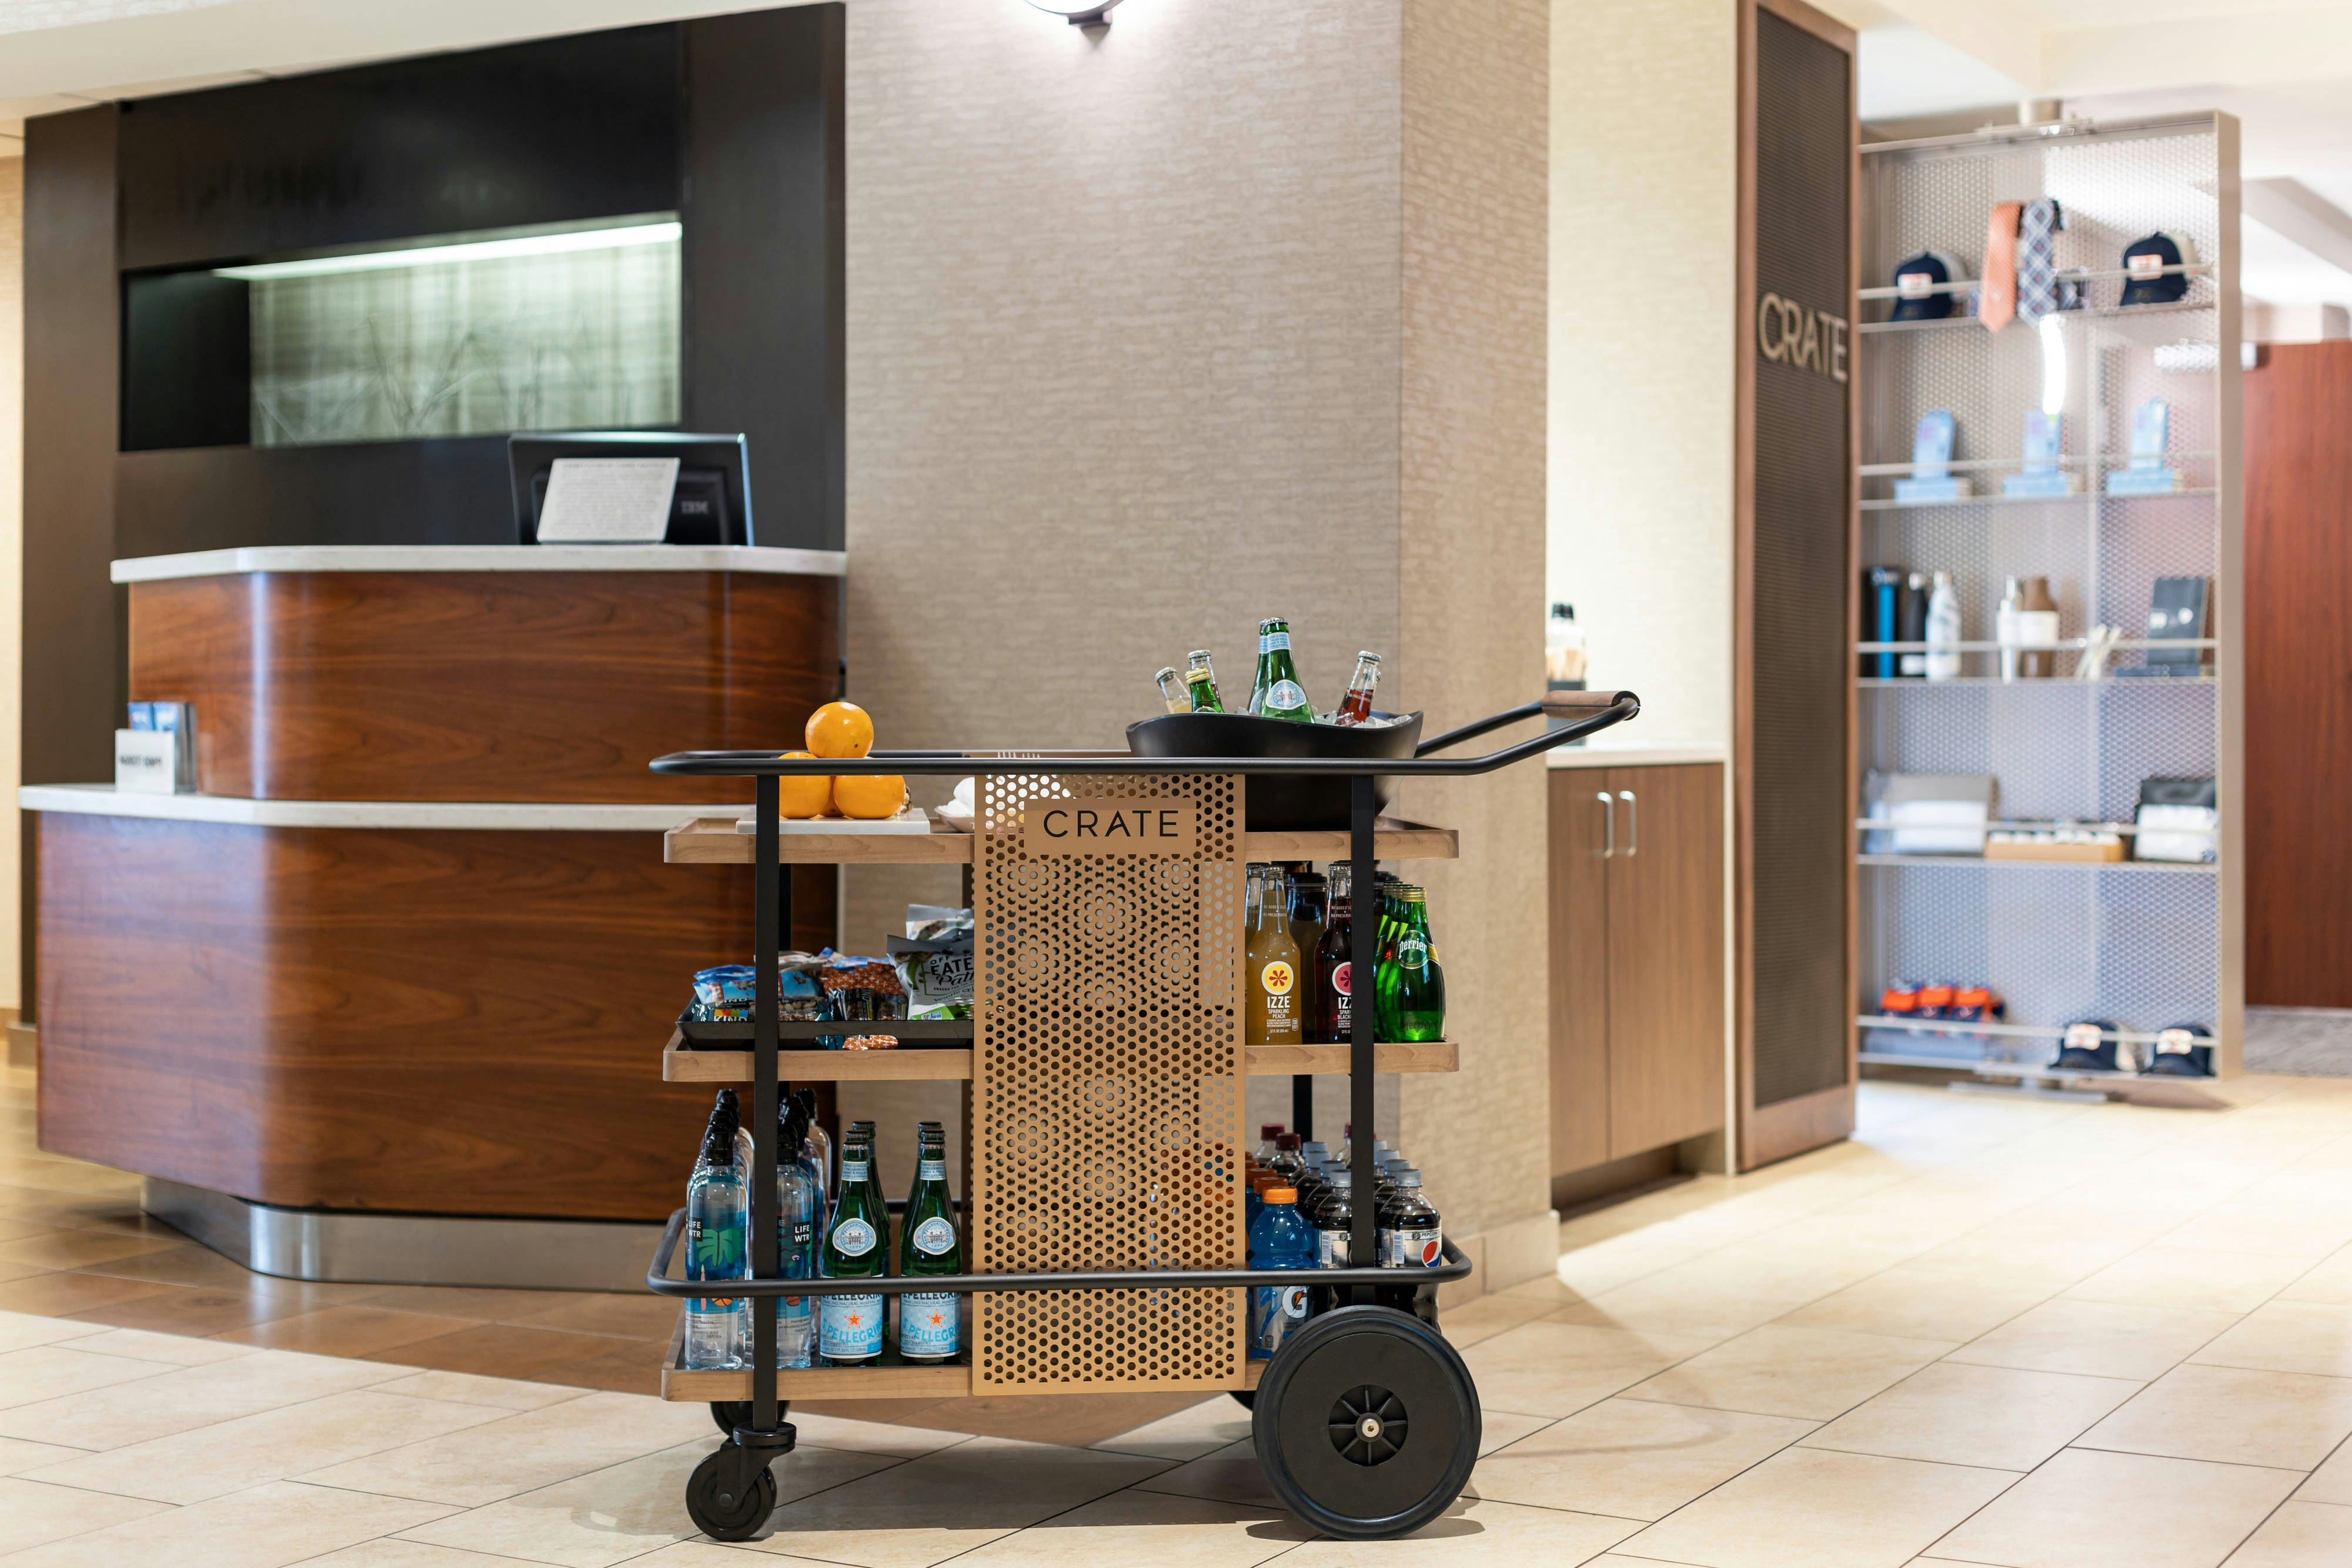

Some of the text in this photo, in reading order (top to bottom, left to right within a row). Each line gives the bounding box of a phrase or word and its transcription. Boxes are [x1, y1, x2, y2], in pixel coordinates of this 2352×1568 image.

[1759, 292, 1847, 382] CRATE
[1044, 810, 1178, 838] CRATE
[930, 955, 950, 965] OFF
[1267, 996, 1290, 1008] IZZE
[688, 1229, 701, 1238] WTR
[795, 1225, 810, 1233] LIFE
[795, 1234, 809, 1242] WTR
